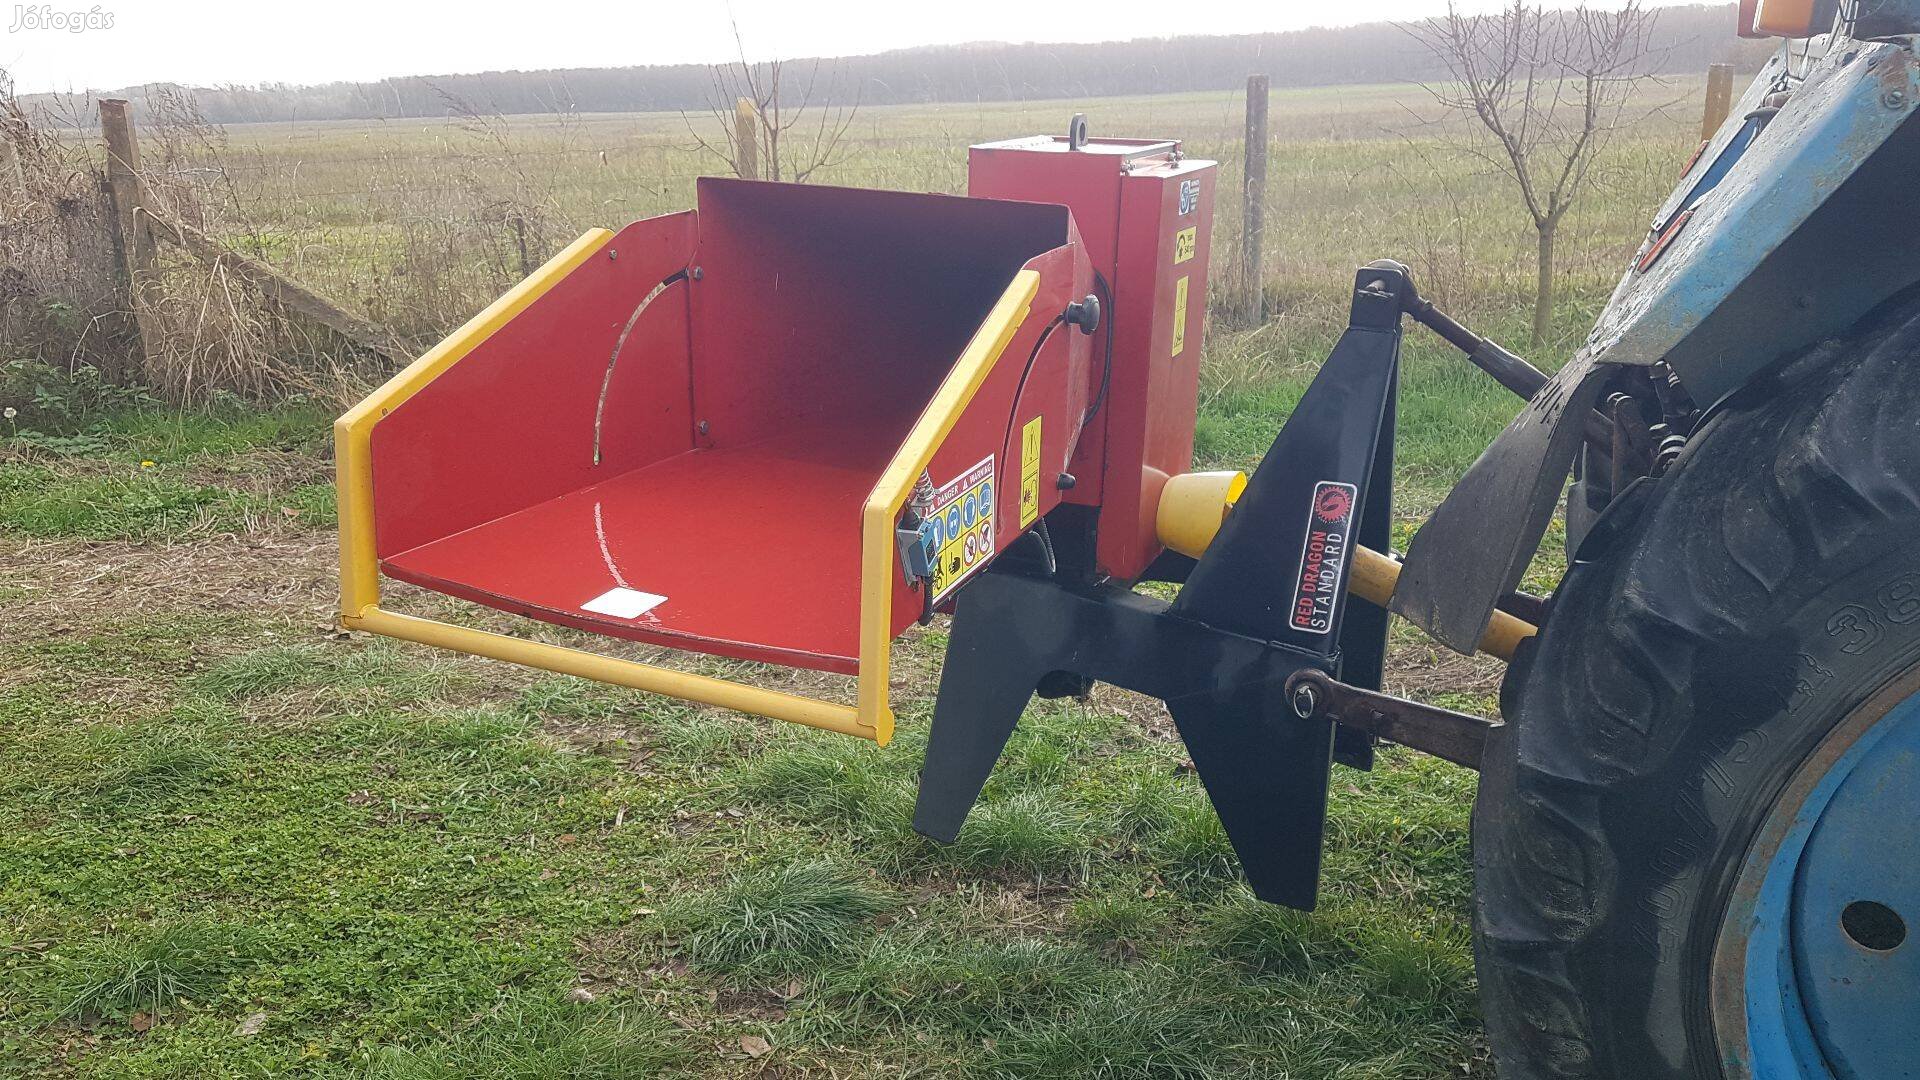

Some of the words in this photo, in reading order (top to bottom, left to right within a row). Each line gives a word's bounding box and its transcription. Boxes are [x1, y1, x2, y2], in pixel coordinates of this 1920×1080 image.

[937, 484, 959, 506] DANGER
[969, 463, 991, 484] WARNING
[1302, 531, 1327, 593] DRAGON
[1311, 533, 1342, 628] STANDARD
[1296, 597, 1314, 626] RED
